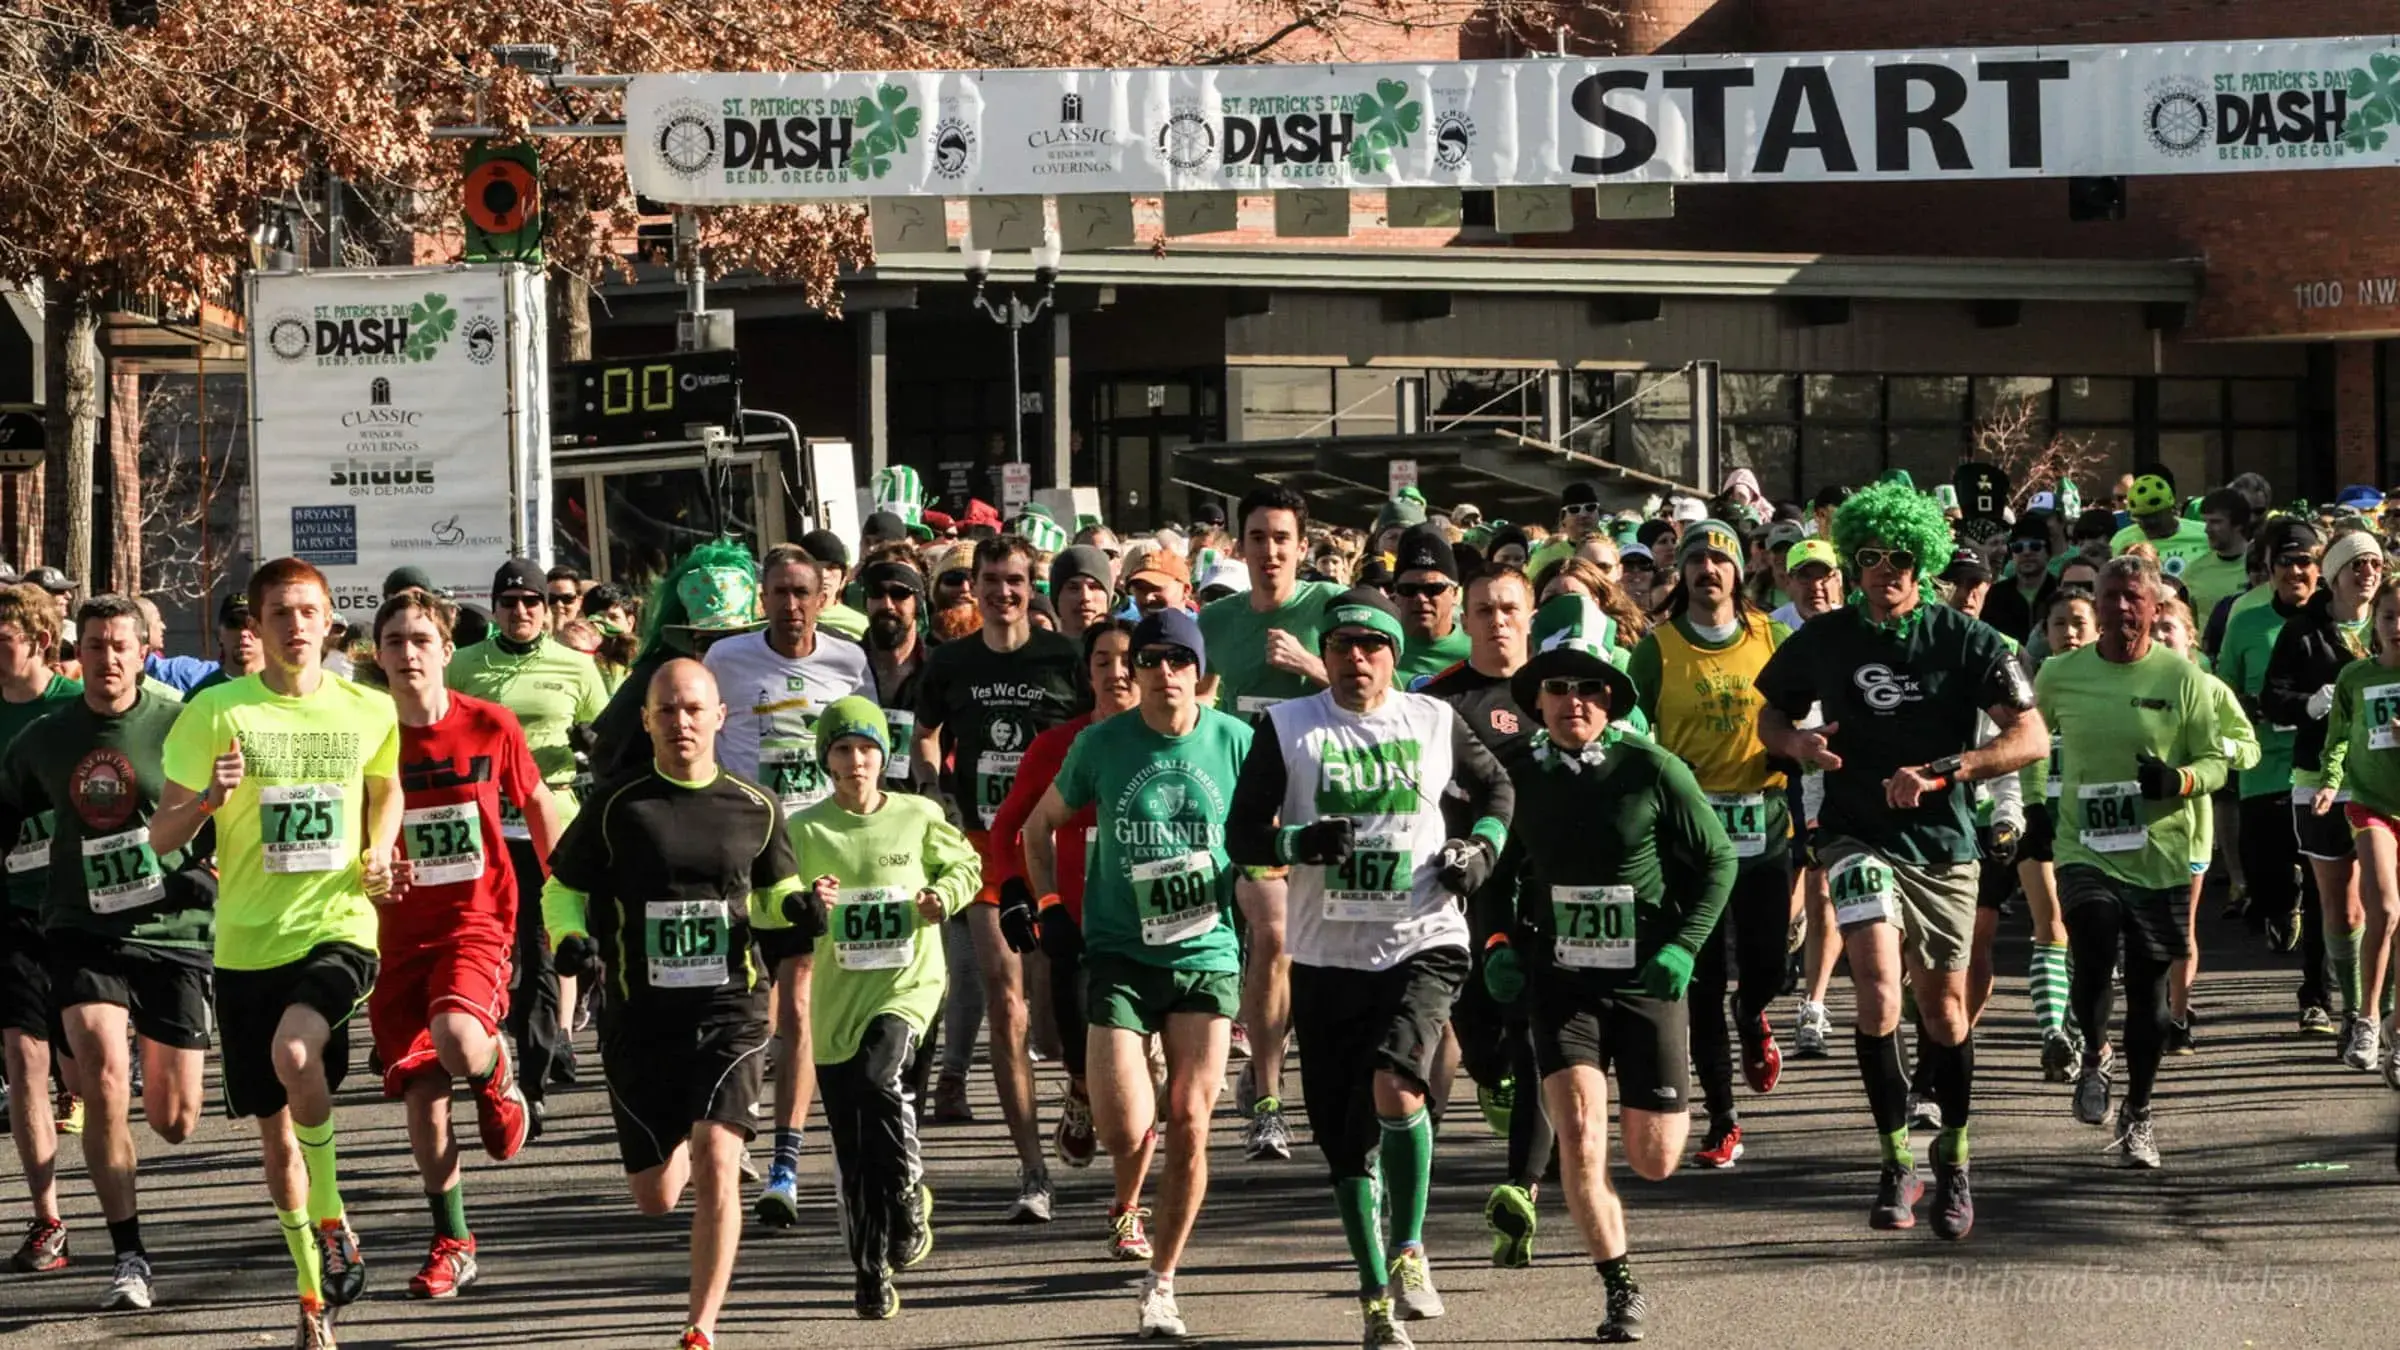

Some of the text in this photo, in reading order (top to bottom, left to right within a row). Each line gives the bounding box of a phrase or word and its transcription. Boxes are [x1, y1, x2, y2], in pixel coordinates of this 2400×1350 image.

[2214, 74, 2236, 92] ST.
[2242, 70, 2318, 91] PATRICK'S
[722, 98, 746, 116] ST.
[750, 95, 825, 116] PATRICK'S
[1222, 96, 1245, 115] ST.
[1249, 93, 1325, 115] PATRICK'S
[1571, 60, 2070, 174] START
[2216, 89, 2347, 145] DASH
[723, 117, 854, 170] DASH
[1028, 128, 1115, 148] CLASSIC
[1222, 113, 1354, 165] DASH
[2275, 143, 2344, 159] OREGON
[781, 168, 848, 184] OREGON
[1032, 160, 1113, 174] COVERINGS
[2292, 280, 2343, 310] 1100
[315, 317, 409, 356] DASH
[357, 354, 407, 366] OREGON
[341, 408, 424, 427] CLASSIC
[346, 442, 420, 453] COVERINGS
[359, 430, 404, 439] WINDOW
[330, 456, 435, 486] shade
[349, 485, 434, 496] ON DEMAND
[1708, 531, 1737, 554] UO
[351, 585, 369, 593] THE
[971, 686, 992, 700] Yes
[993, 683, 1015, 697] We
[1903, 681, 1919, 691] 5K
[290, 732, 359, 759] COUGARS
[302, 759, 327, 778] FOR
[1322, 761, 1416, 793] RUN
[1116, 759, 1195, 812] TRADITIONALLY
[1195, 766, 1225, 815] BREWED
[272, 801, 334, 843] 725
[1715, 806, 1756, 833] 14
[2085, 795, 2136, 829] 684
[416, 820, 476, 858] 532
[1115, 817, 1225, 848] GUINNESS
[1134, 846, 1173, 857] EXTRA
[91, 848, 150, 888] 512
[1338, 851, 1401, 892] 467
[1150, 871, 1206, 914] 480
[844, 902, 902, 941] 645
[1565, 902, 1621, 939] 730
[659, 918, 717, 957] 605
